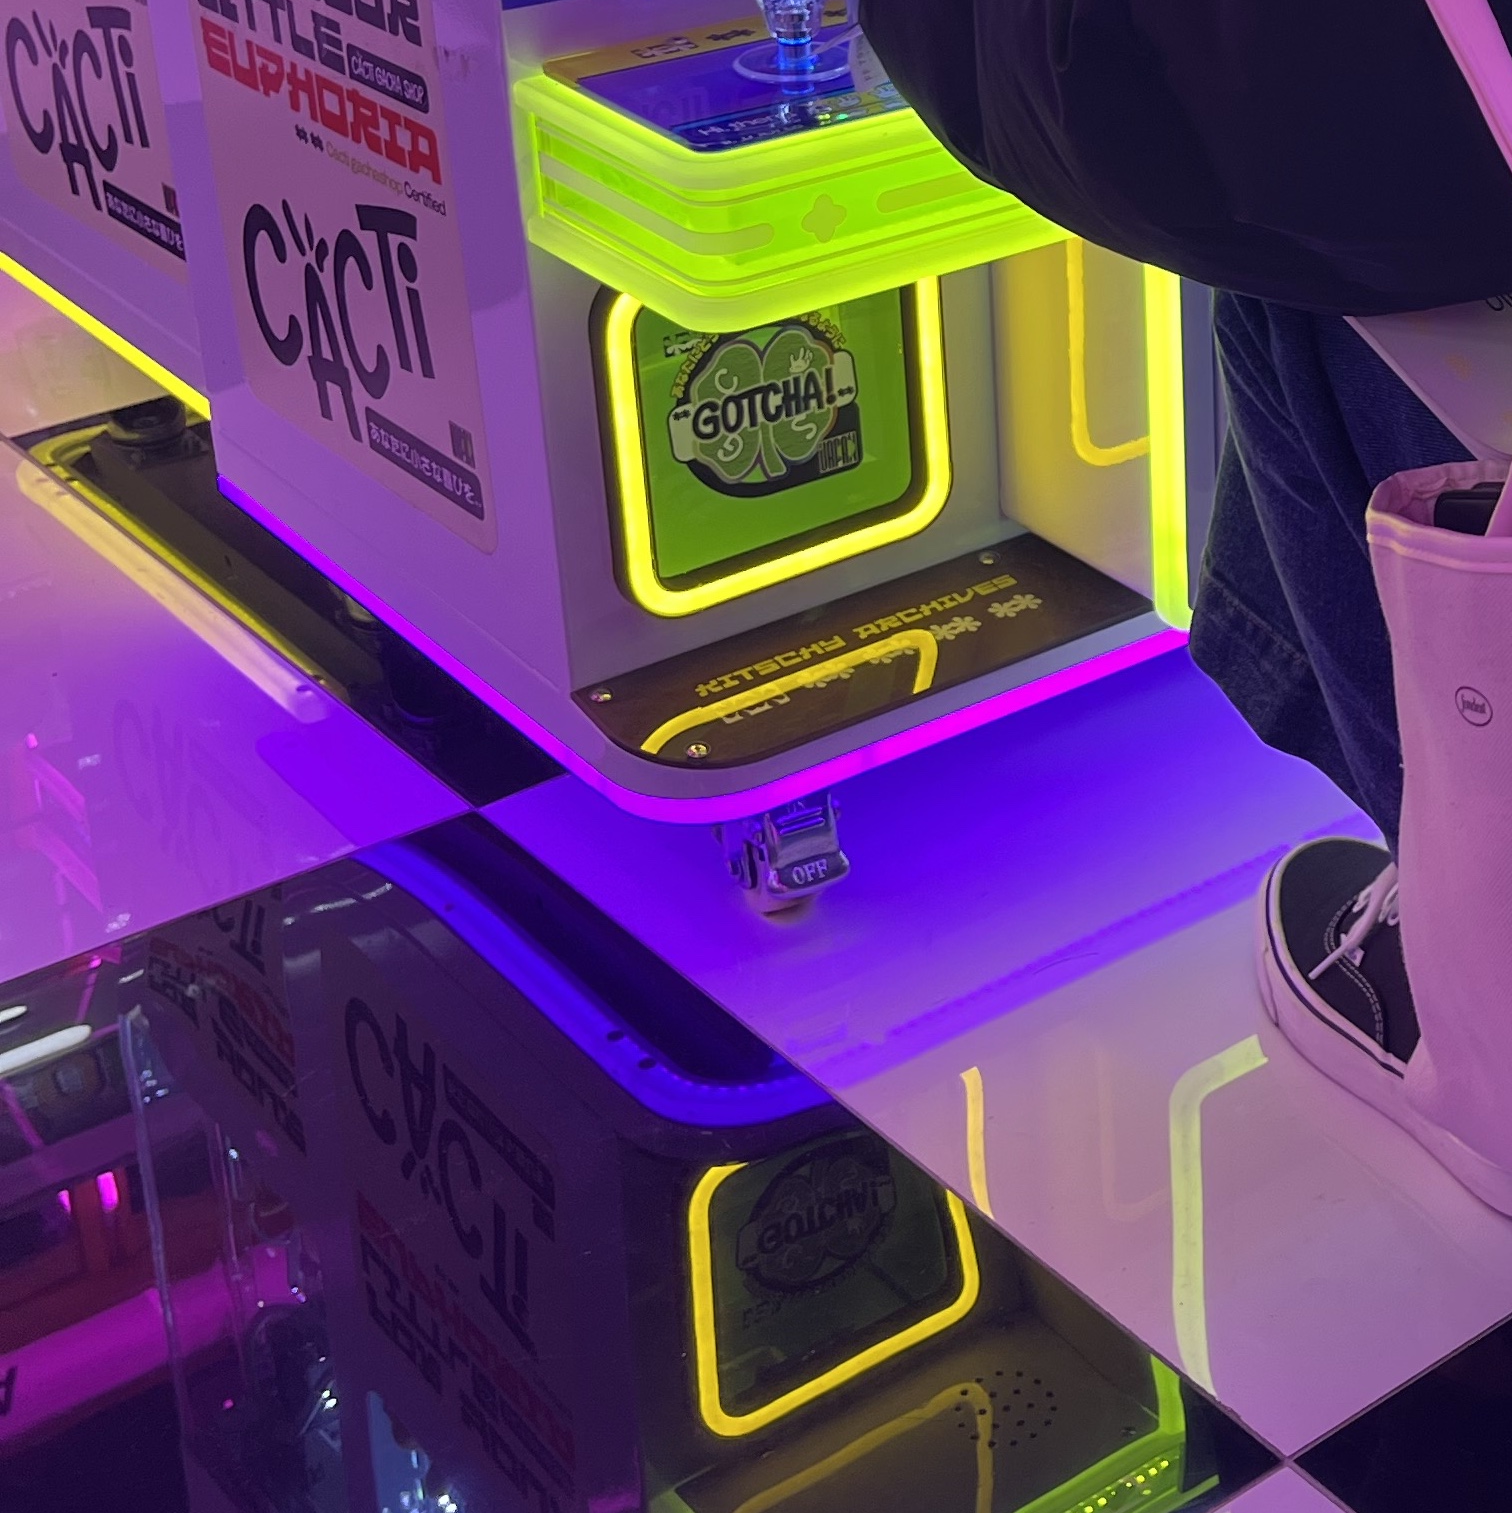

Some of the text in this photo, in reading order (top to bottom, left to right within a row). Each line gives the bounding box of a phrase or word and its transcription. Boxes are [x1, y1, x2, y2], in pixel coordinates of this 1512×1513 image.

[201, 16, 442, 186] EUPHORIA
[692, 368, 836, 441] GOTCHA!
[695, 573, 1018, 697] KITSCHY ARCHIVES
[791, 858, 828, 885] OFF
